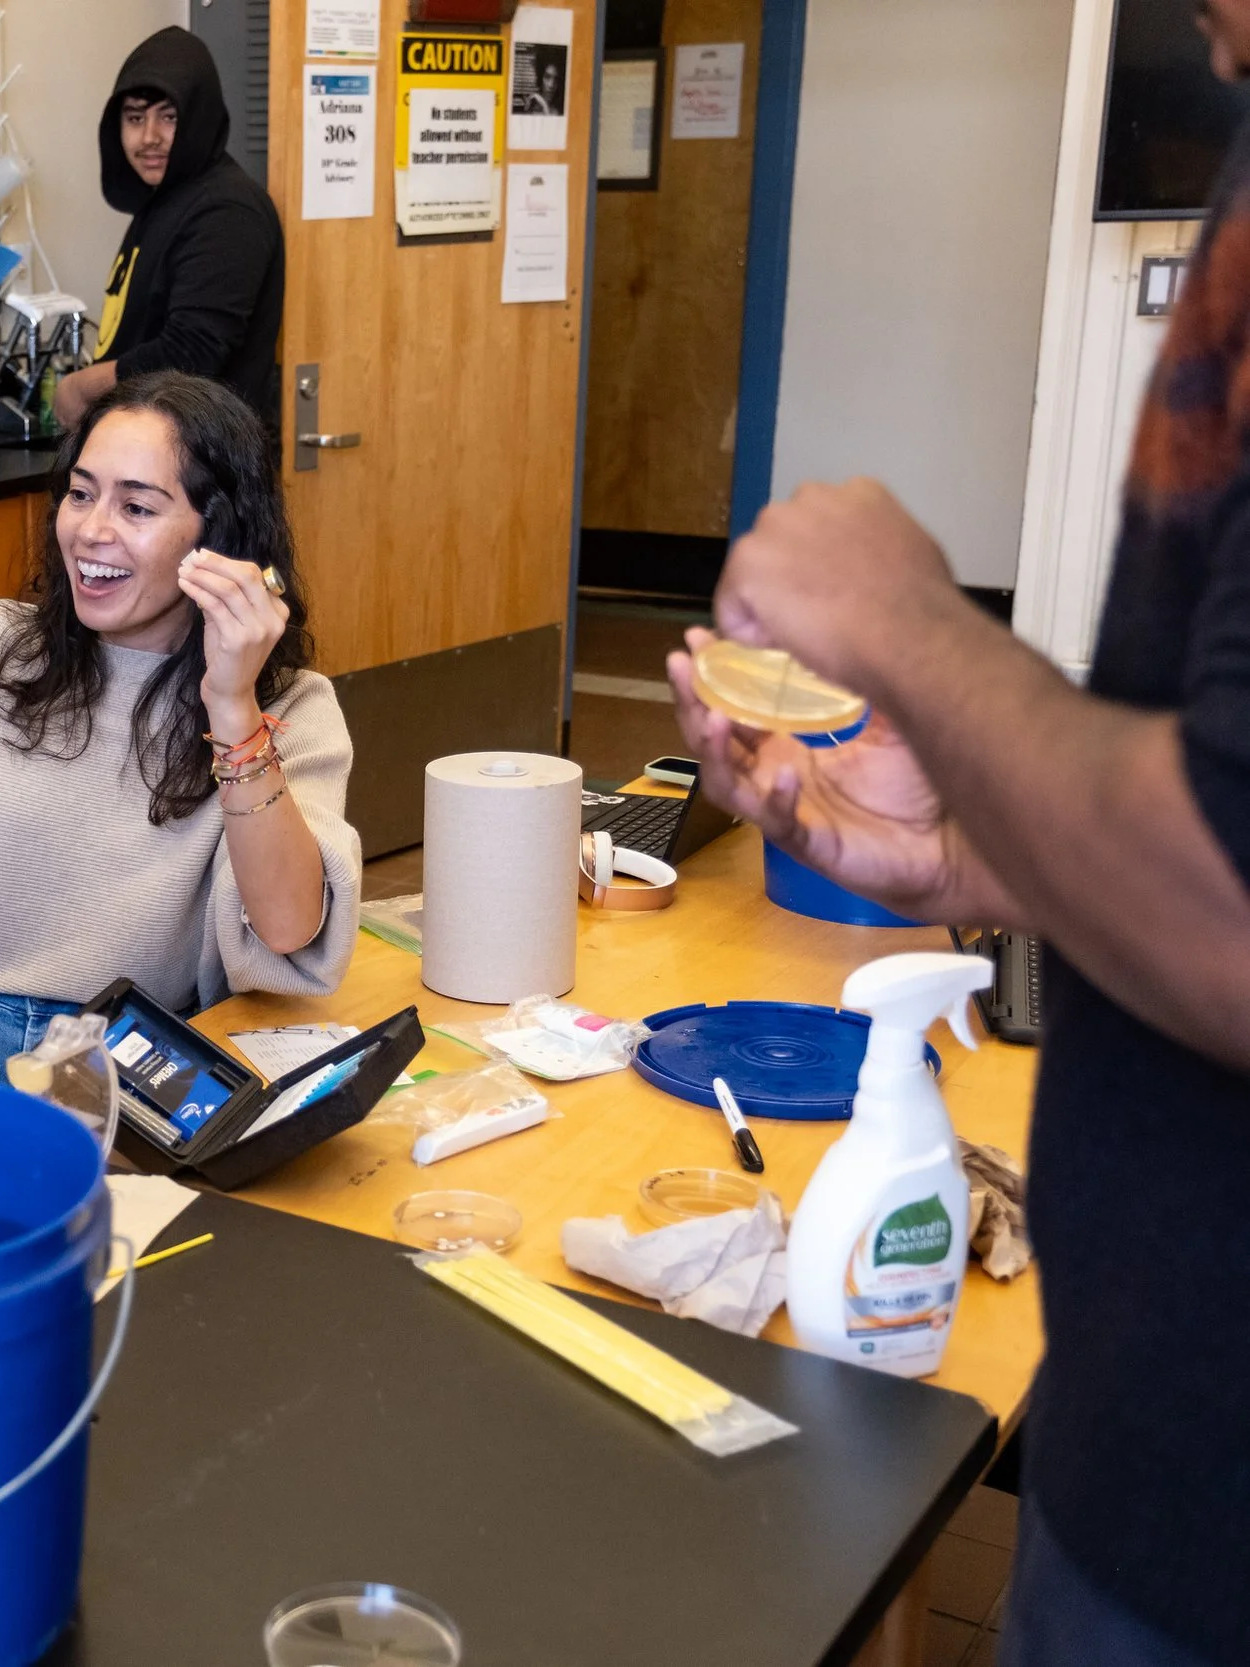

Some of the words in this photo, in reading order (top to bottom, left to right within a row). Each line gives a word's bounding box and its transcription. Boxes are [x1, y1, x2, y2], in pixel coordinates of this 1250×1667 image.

[407, 42, 498, 71] CAUTION
[320, 100, 363, 114] Adriana
[443, 109, 477, 121] students
[325, 125, 356, 144] 308
[420, 129, 451, 142] allowed
[454, 130, 482, 142] without
[412, 152, 443, 164] teacher
[446, 152, 488, 165] permission
[881, 1219, 948, 1241] seventh
